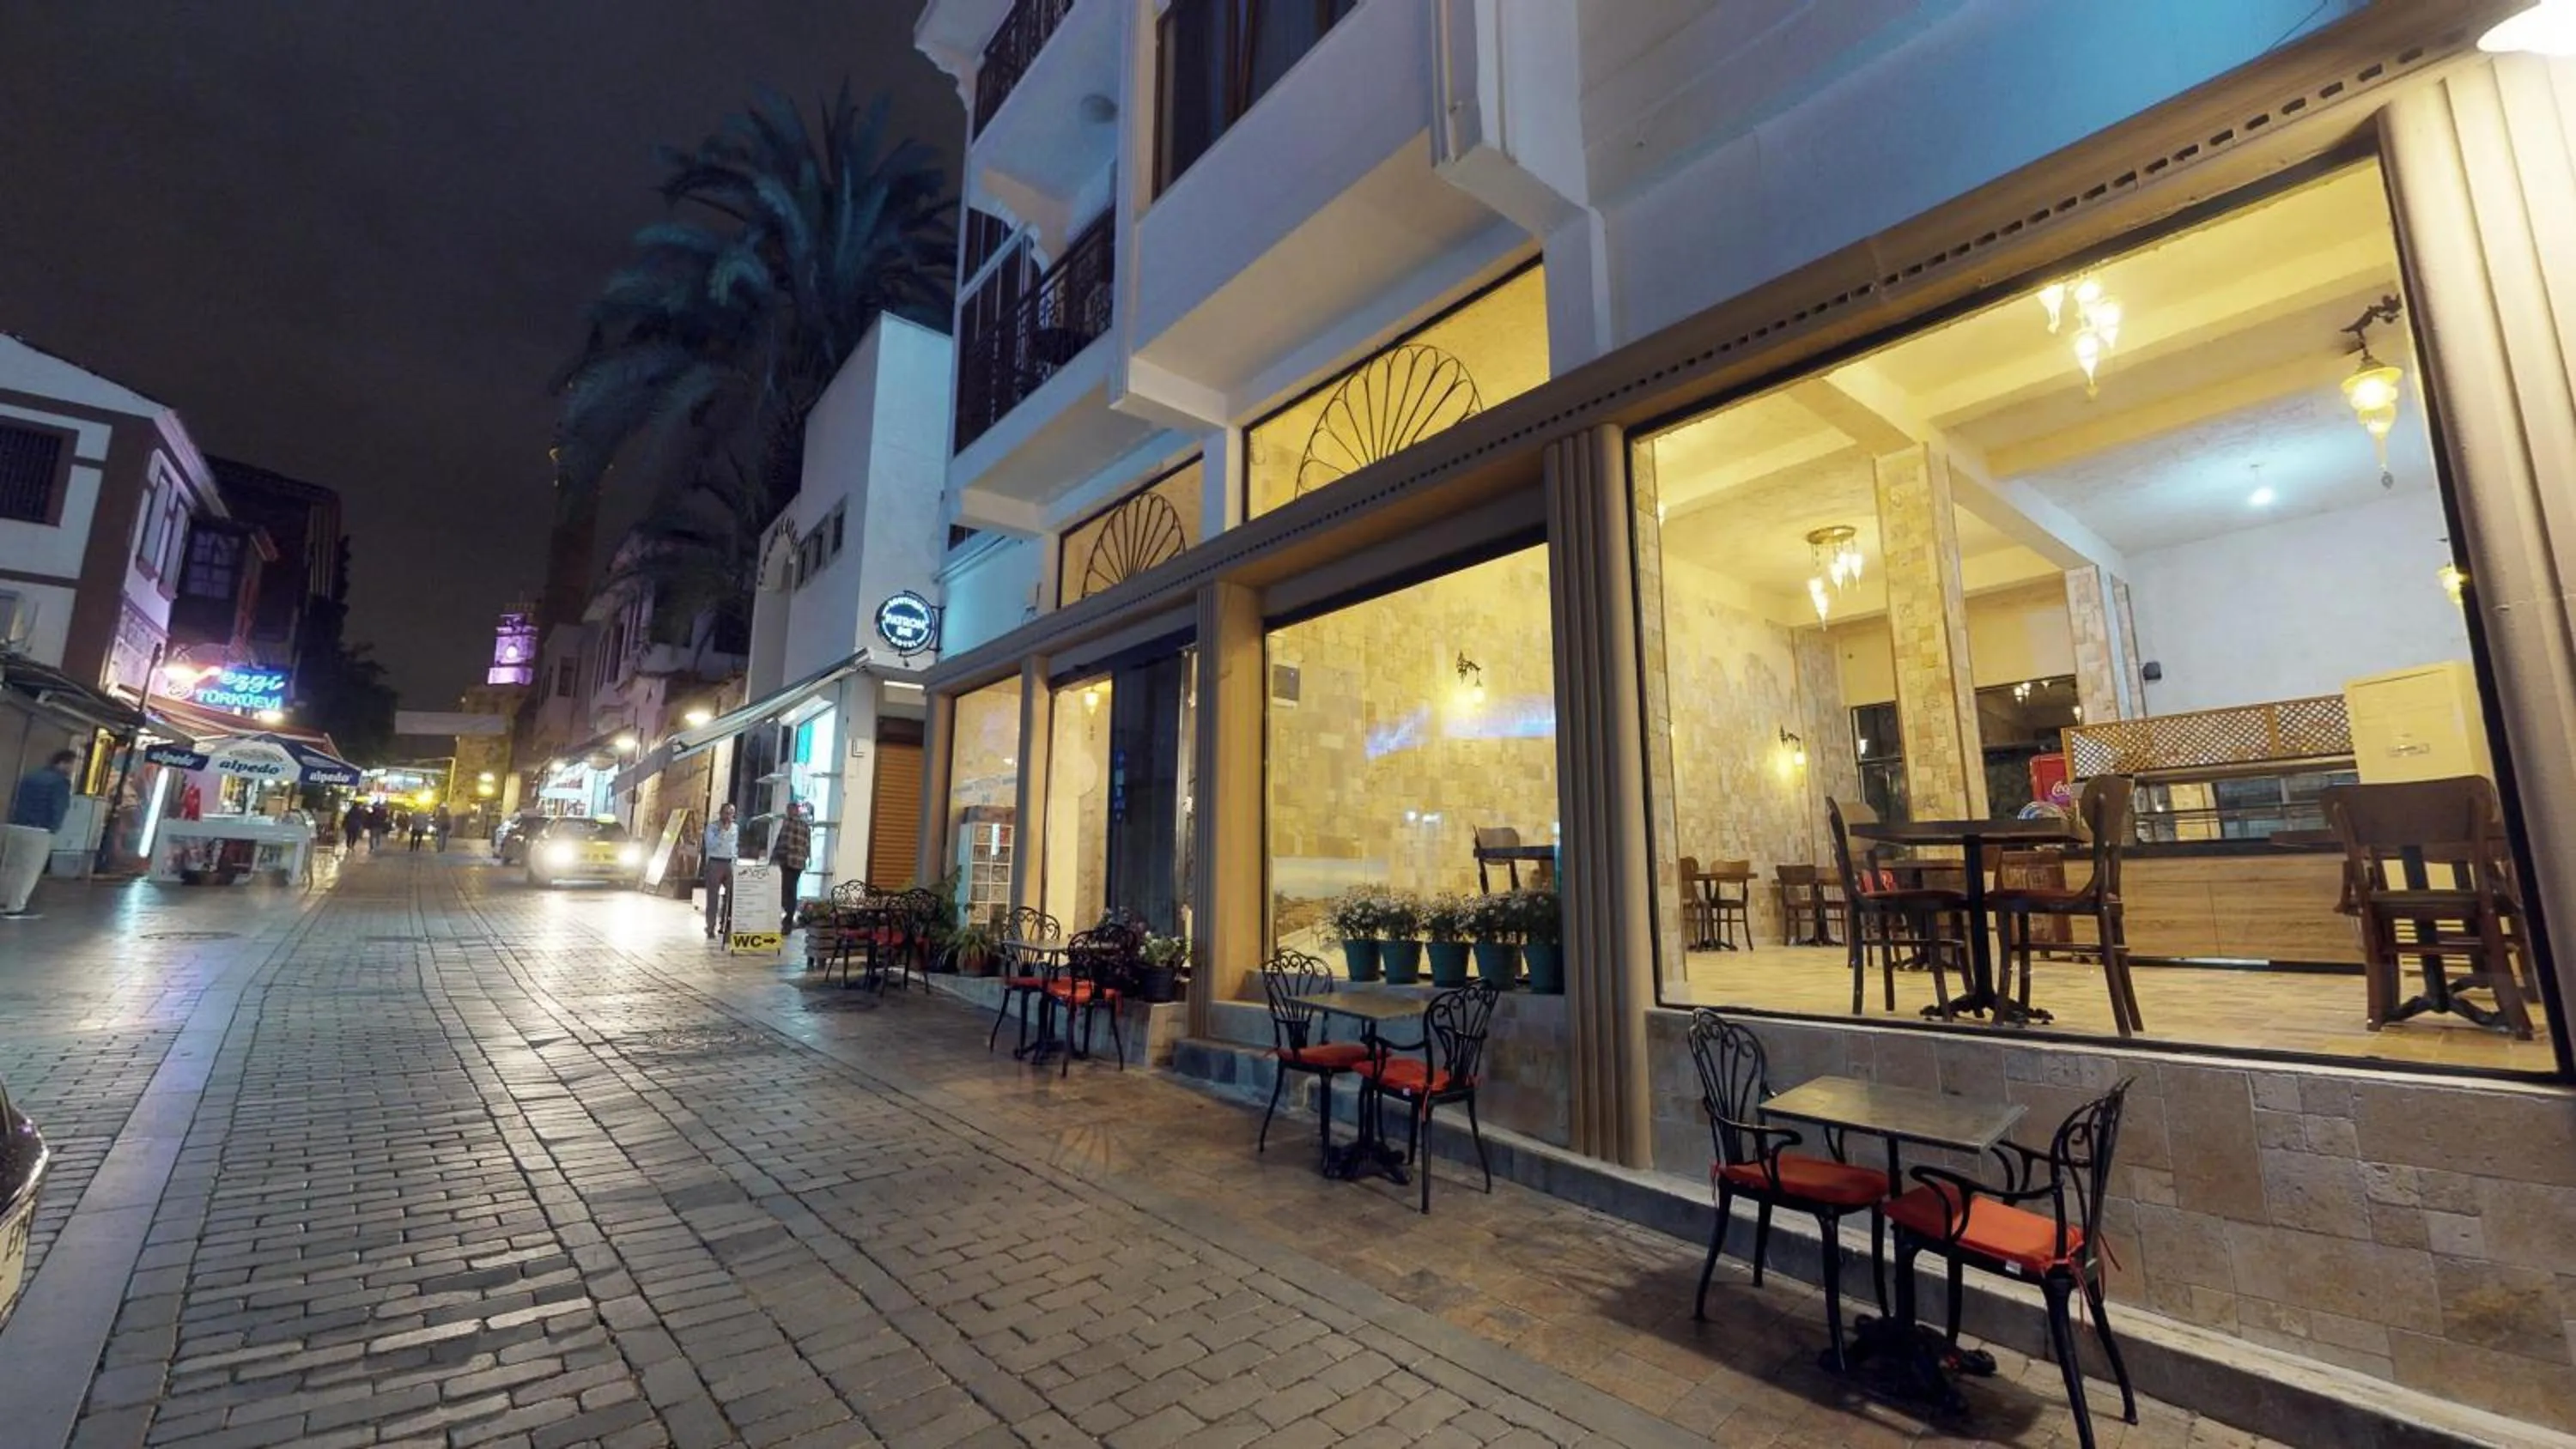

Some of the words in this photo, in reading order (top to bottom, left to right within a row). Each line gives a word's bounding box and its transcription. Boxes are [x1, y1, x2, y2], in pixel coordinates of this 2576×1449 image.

[220, 670, 285, 693] ezgi
[219, 759, 281, 775] alpedo
[308, 769, 350, 783] alpedo
[732, 935, 762, 949] WC
